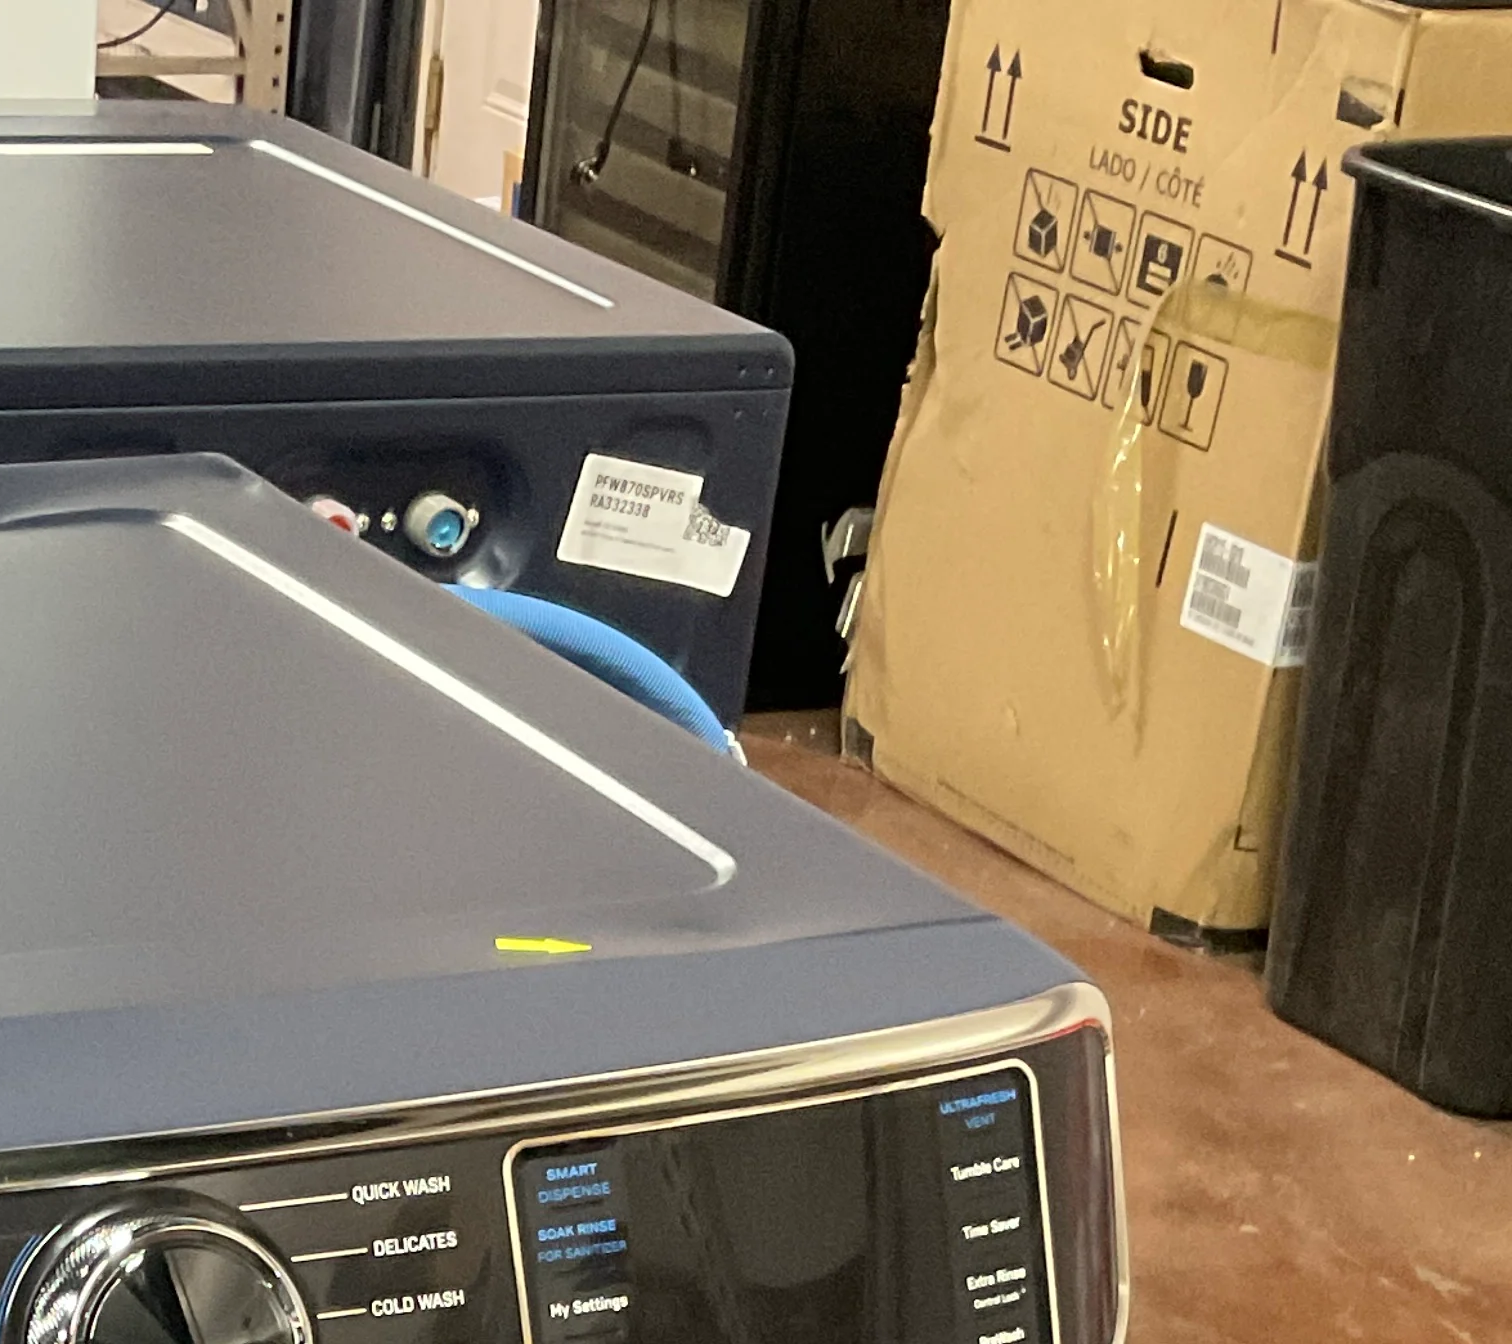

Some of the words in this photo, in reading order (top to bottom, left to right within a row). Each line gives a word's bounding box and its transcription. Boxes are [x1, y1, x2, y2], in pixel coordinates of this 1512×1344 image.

[1118, 98, 1192, 153] SIDE
[1089, 145, 1136, 182] LADO
[1138, 161, 1151, 191] /
[1156, 166, 1204, 208] CÔTÉ
[594, 474, 684, 505] PFW870SPVRS
[589, 495, 651, 518] RA332338
[546, 1162, 598, 1181] SMART
[950, 1161, 992, 1181] Tumble
[993, 1156, 1020, 1173] Care
[352, 1181, 400, 1205] QUICK
[403, 1175, 451, 1196] WASH
[538, 1181, 611, 1204] DISPENSE
[538, 1225, 575, 1241] SOAK
[577, 1218, 616, 1236] RINSE
[372, 1230, 458, 1257] DELICATES
[537, 1249, 562, 1263] FOR
[371, 1296, 414, 1317] COLD
[417, 1289, 465, 1311] WASH
[549, 1303, 570, 1320] My
[572, 1295, 629, 1315] Settings
